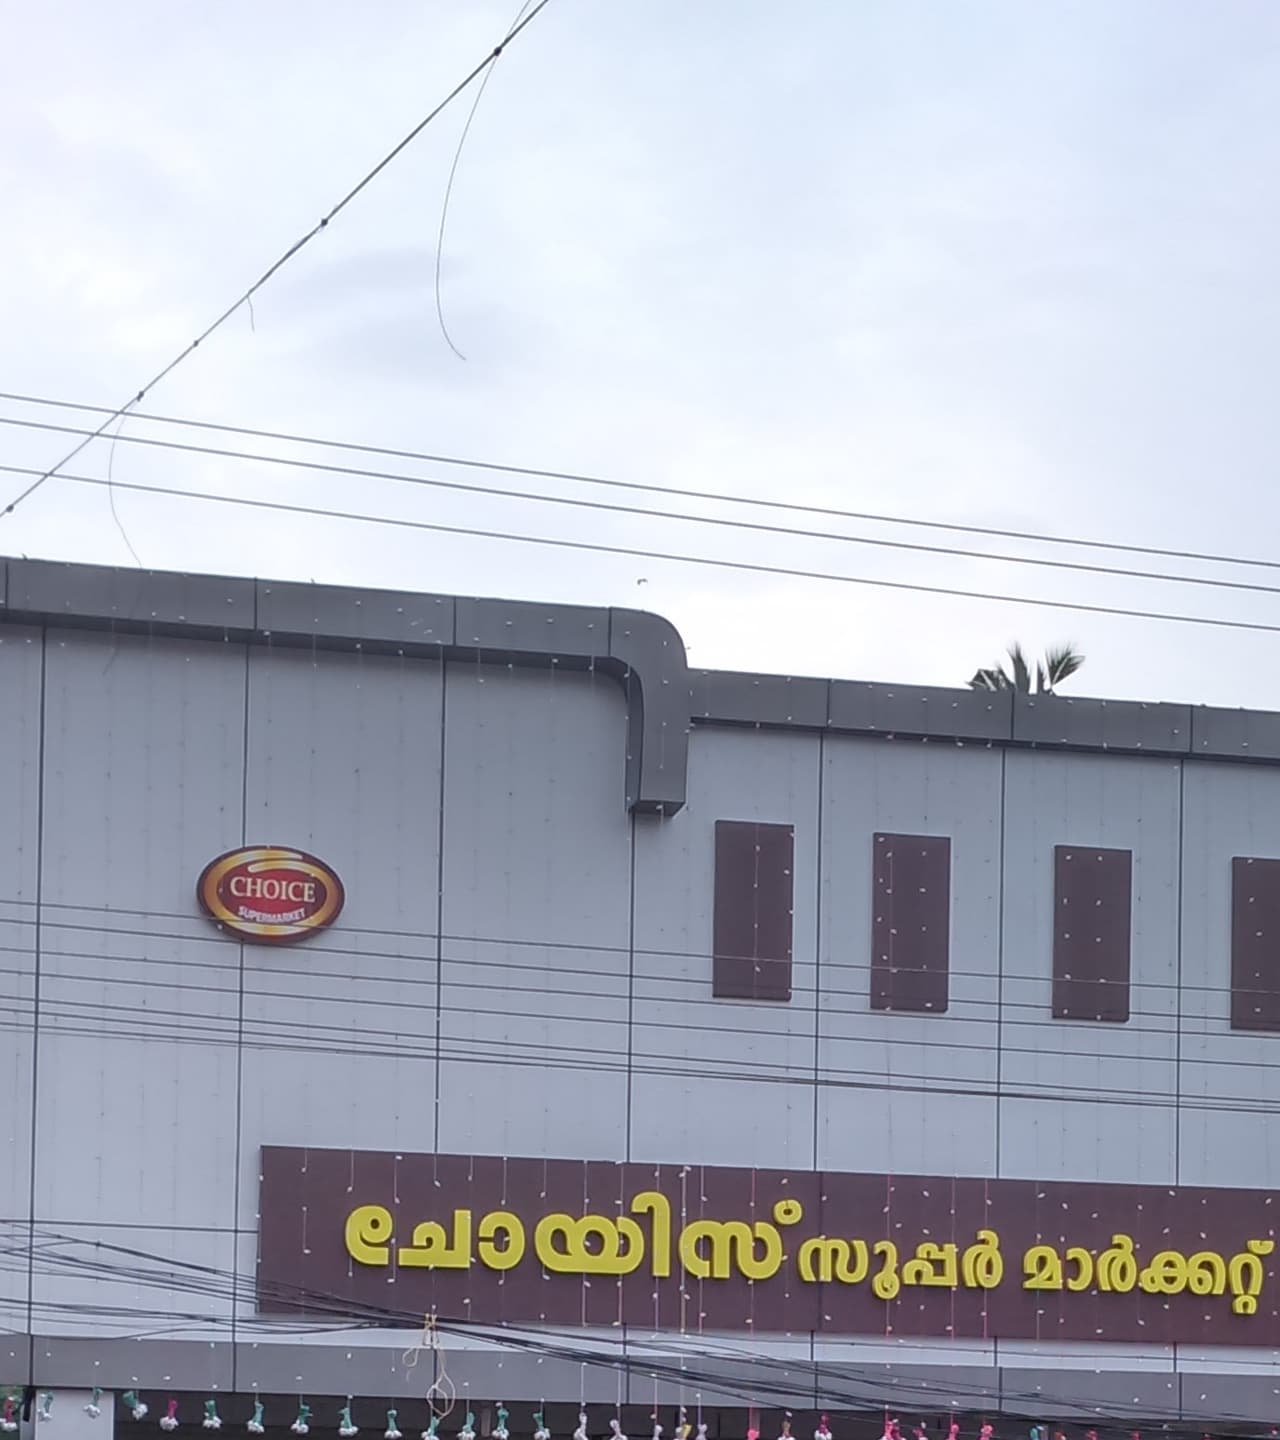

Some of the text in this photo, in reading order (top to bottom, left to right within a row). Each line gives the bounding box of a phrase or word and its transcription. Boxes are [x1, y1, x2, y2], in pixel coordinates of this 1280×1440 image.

[230, 876, 316, 902] CHOICE
[797, 1229, 1003, 1300] സൂപ്പർ
[1023, 1234, 1276, 1315] മാർക്കറ്റ്
